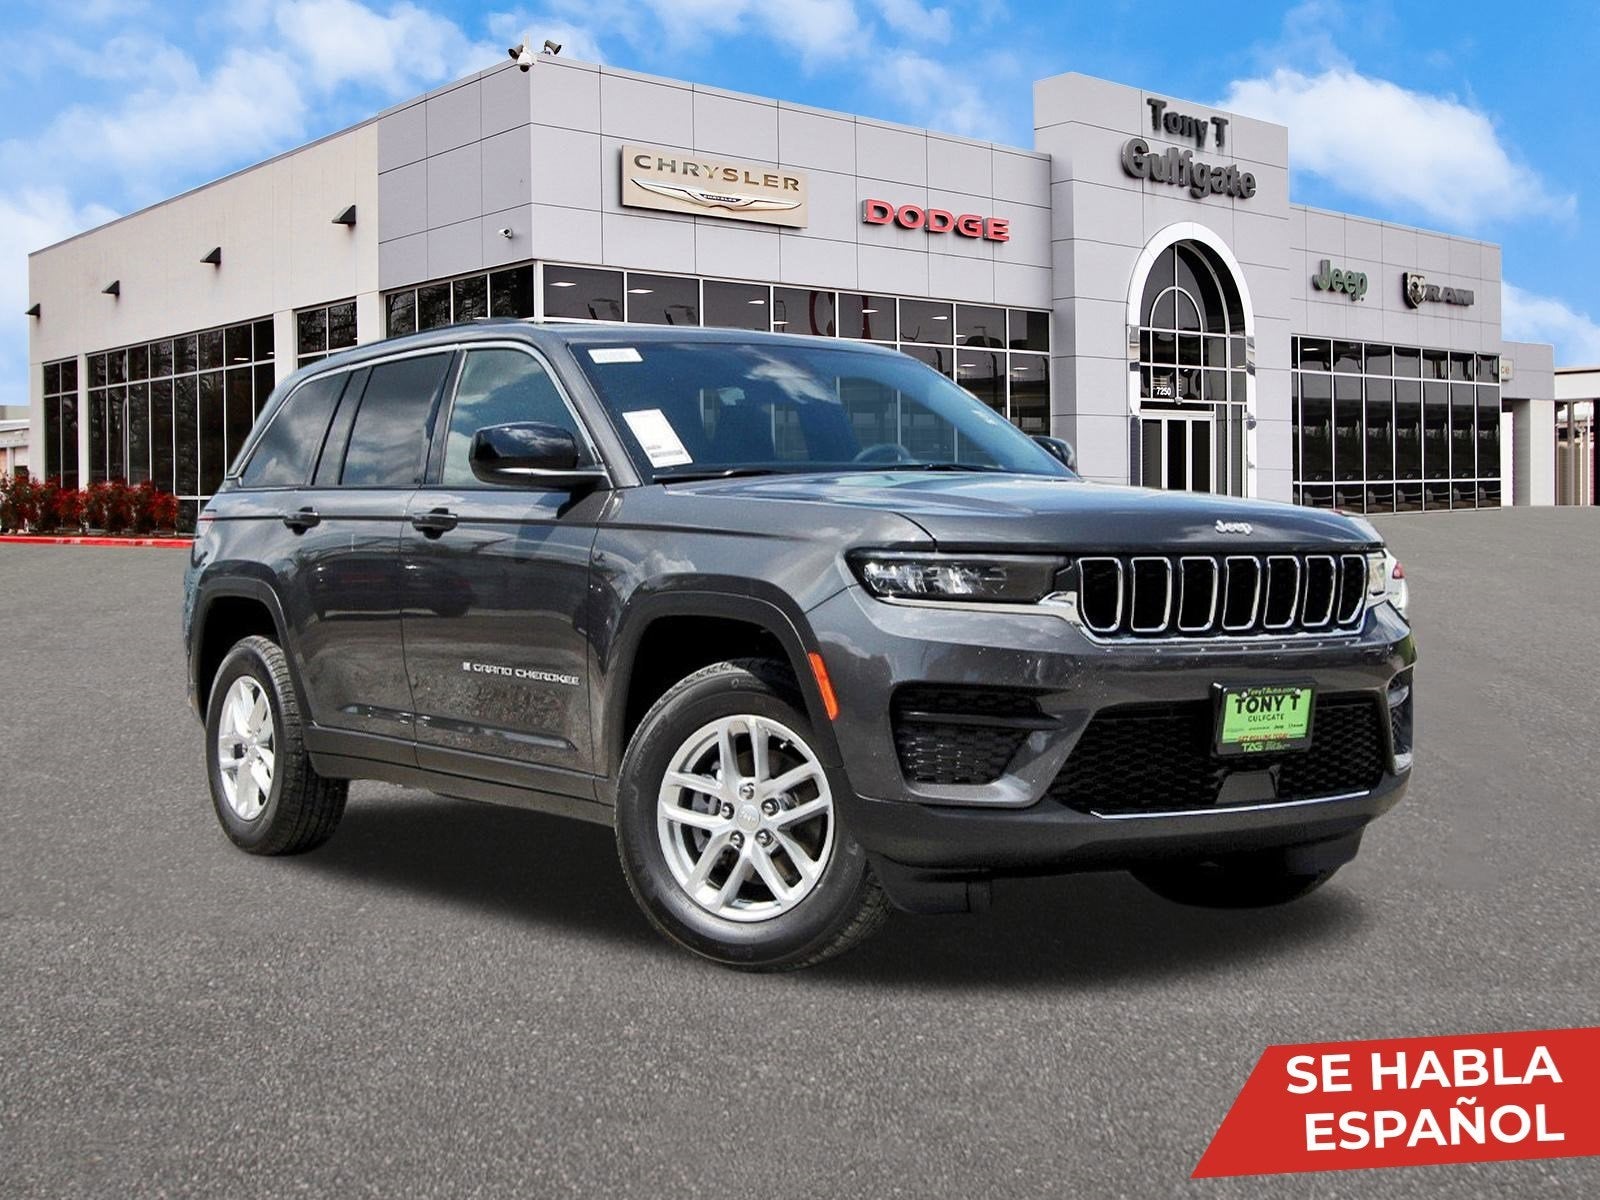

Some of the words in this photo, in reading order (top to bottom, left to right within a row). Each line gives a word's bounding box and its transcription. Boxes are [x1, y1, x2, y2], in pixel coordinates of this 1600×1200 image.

[1147, 98, 1208, 147] Tony
[1210, 116, 1229, 147] T
[634, 154, 800, 192] CHRYSLER
[1121, 138, 1257, 199] Gulfgate
[863, 198, 1010, 242] DODGE
[1312, 259, 1367, 301] Jeep
[1424, 284, 1474, 306] RAM
[1215, 520, 1253, 535] Jeep
[473, 663, 512, 676] GRAND
[515, 668, 580, 685] CHEROKEE
[1235, 696, 1285, 714] TONY
[1290, 694, 1301, 710] T
